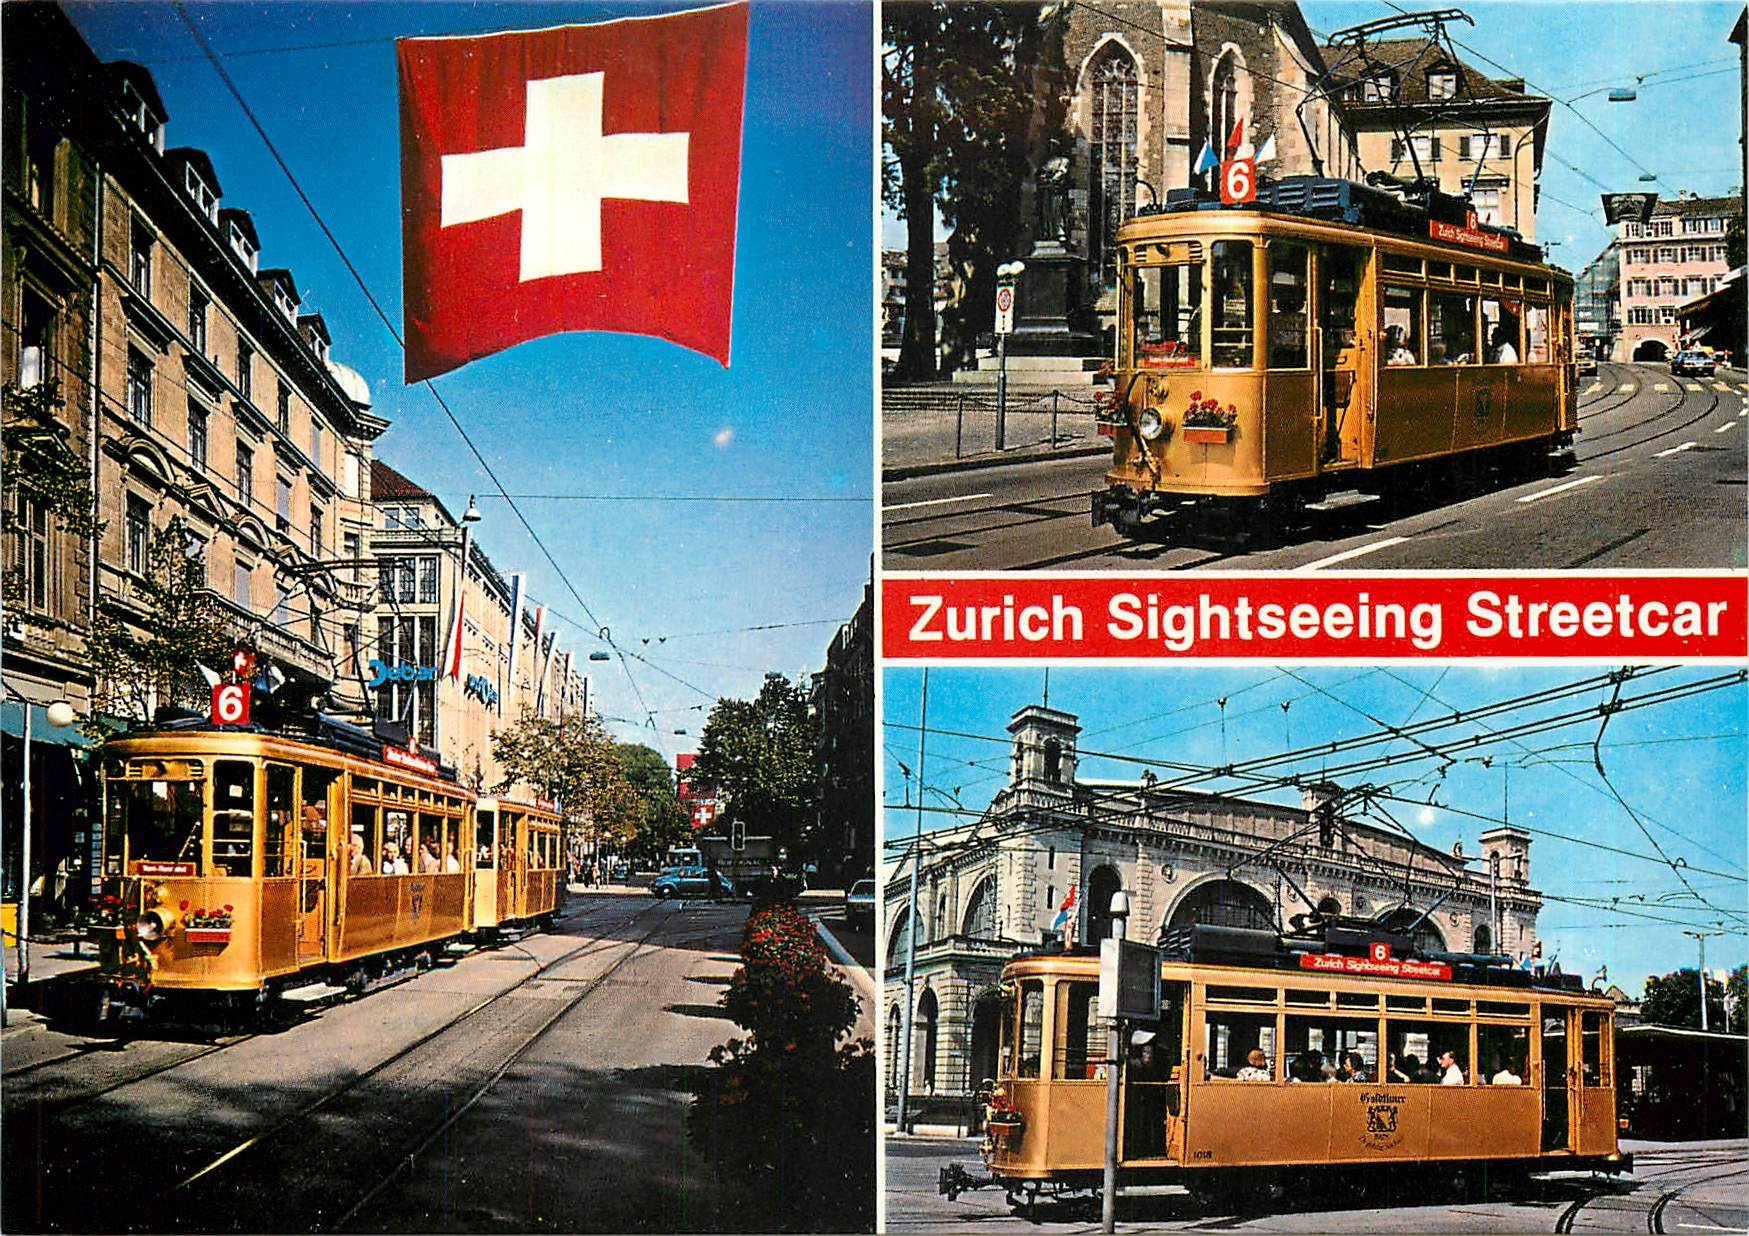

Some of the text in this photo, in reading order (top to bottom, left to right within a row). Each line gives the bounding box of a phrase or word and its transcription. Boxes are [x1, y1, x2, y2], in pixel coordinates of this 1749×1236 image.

[1228, 161, 1249, 199] 6
[1470, 212, 1477, 230] 6
[218, 685, 243, 722] 6
[1374, 945, 1386, 960] 6
[1314, 957, 1441, 976] Zurich Sightseeing Streetcar
